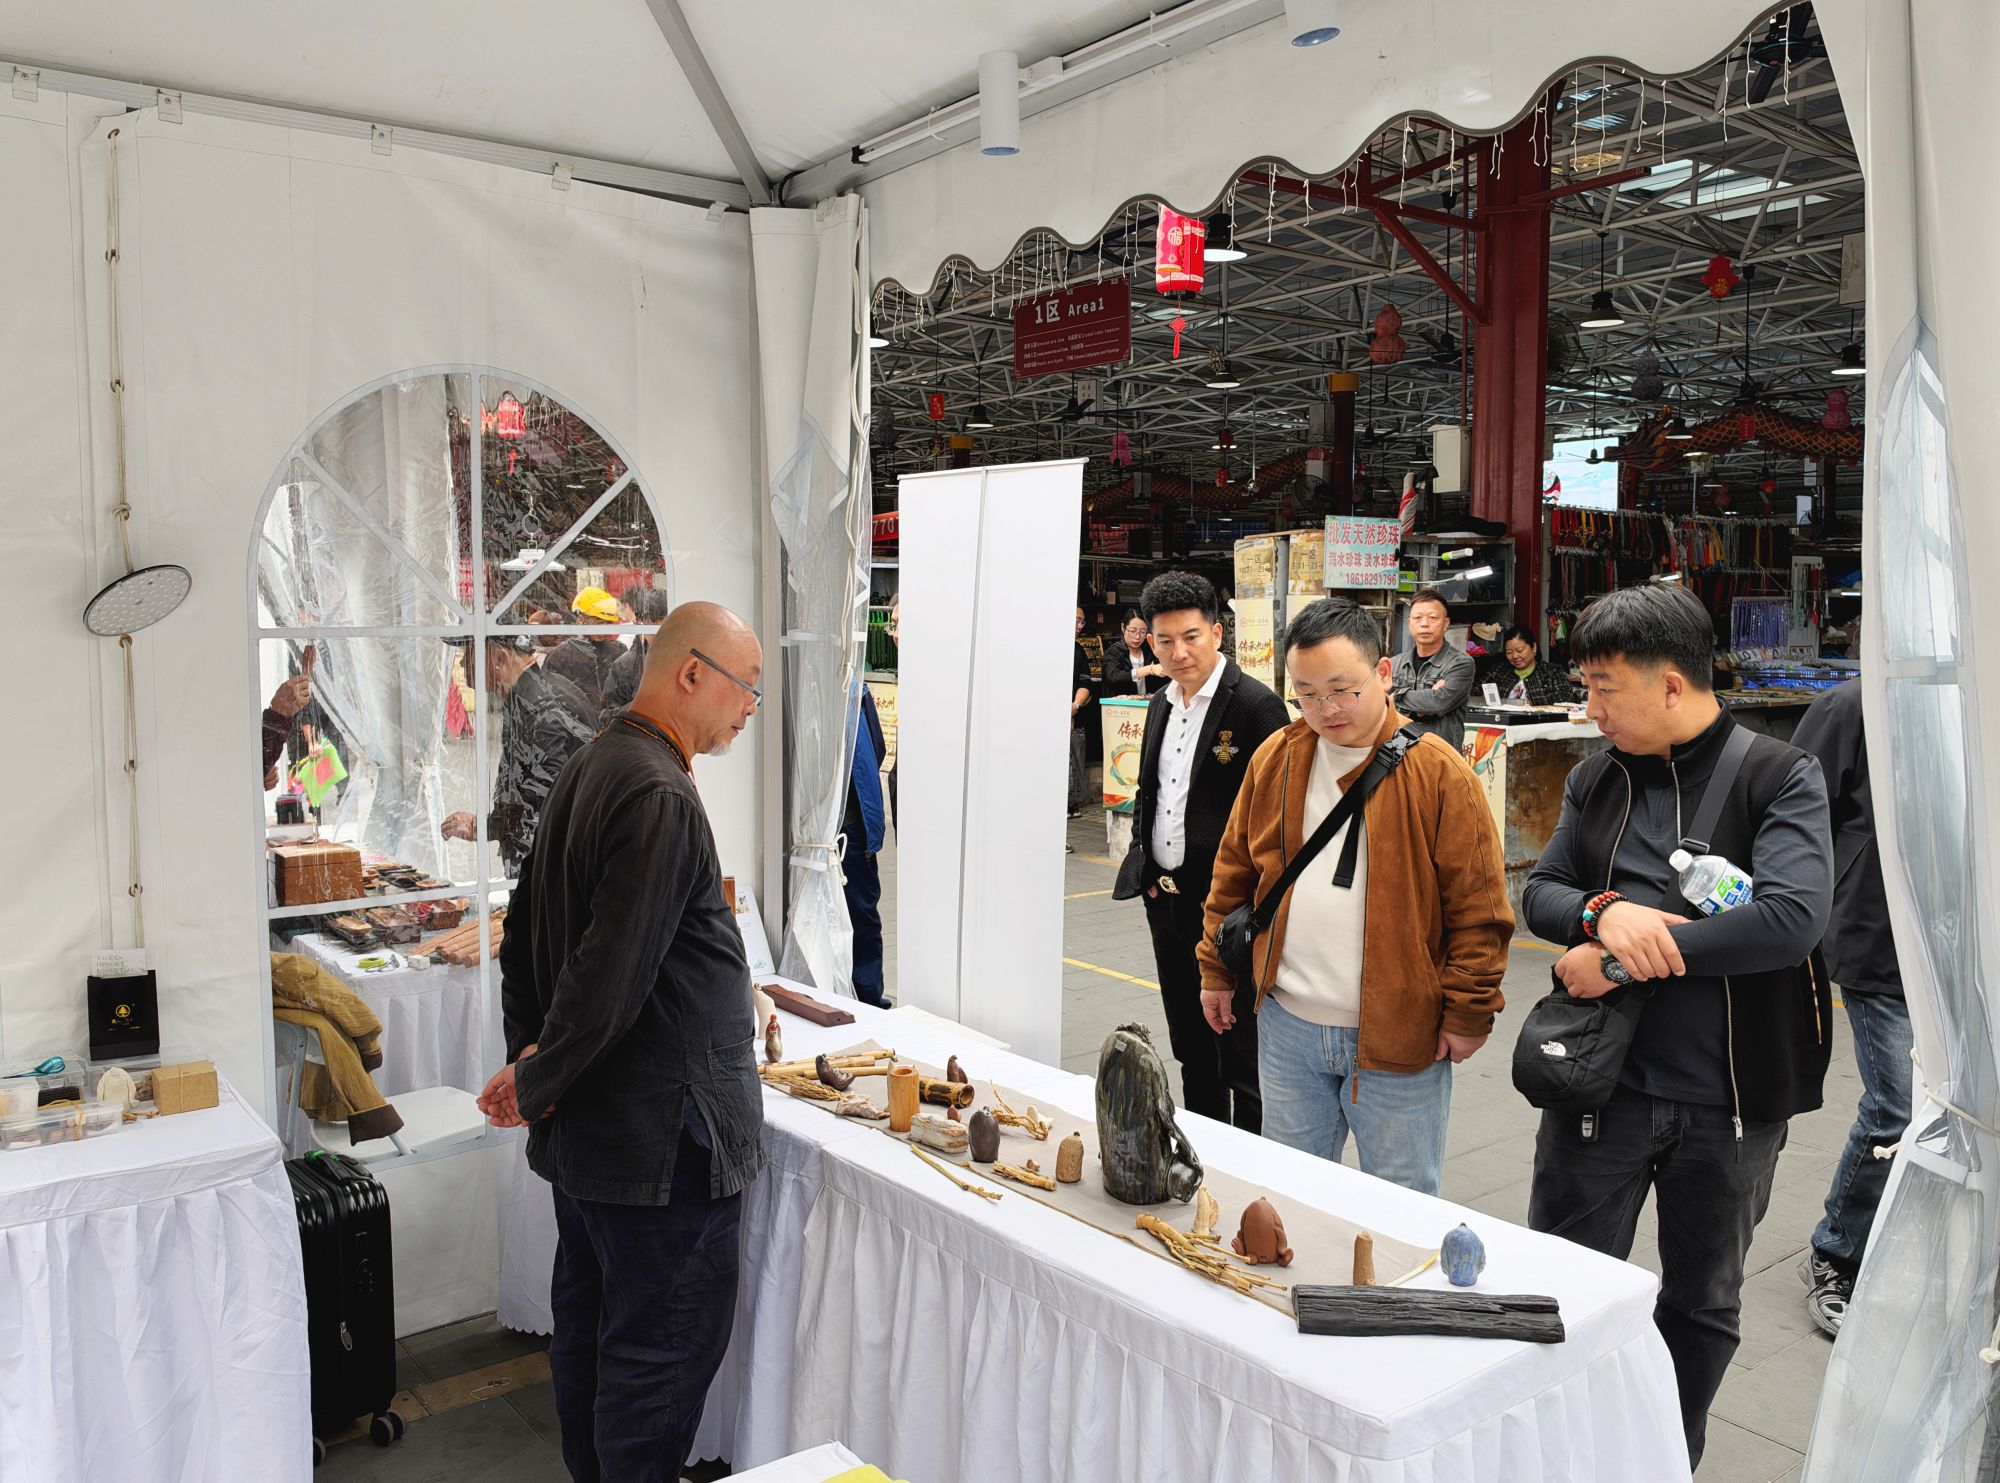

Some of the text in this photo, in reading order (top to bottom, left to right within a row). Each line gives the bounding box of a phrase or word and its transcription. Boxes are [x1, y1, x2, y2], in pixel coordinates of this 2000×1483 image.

[1036, 297, 1104, 324] 1区 Area1
[1328, 521, 1400, 546] 批发天然珍珠
[1328, 552, 1362, 568] 海水珍珠
[1364, 553, 1397, 568] 淡水珍珠
[1345, 573, 1397, 586] 18618291796
[871, 696, 895, 711] 承九州
[1117, 720, 1144, 739] 传承
